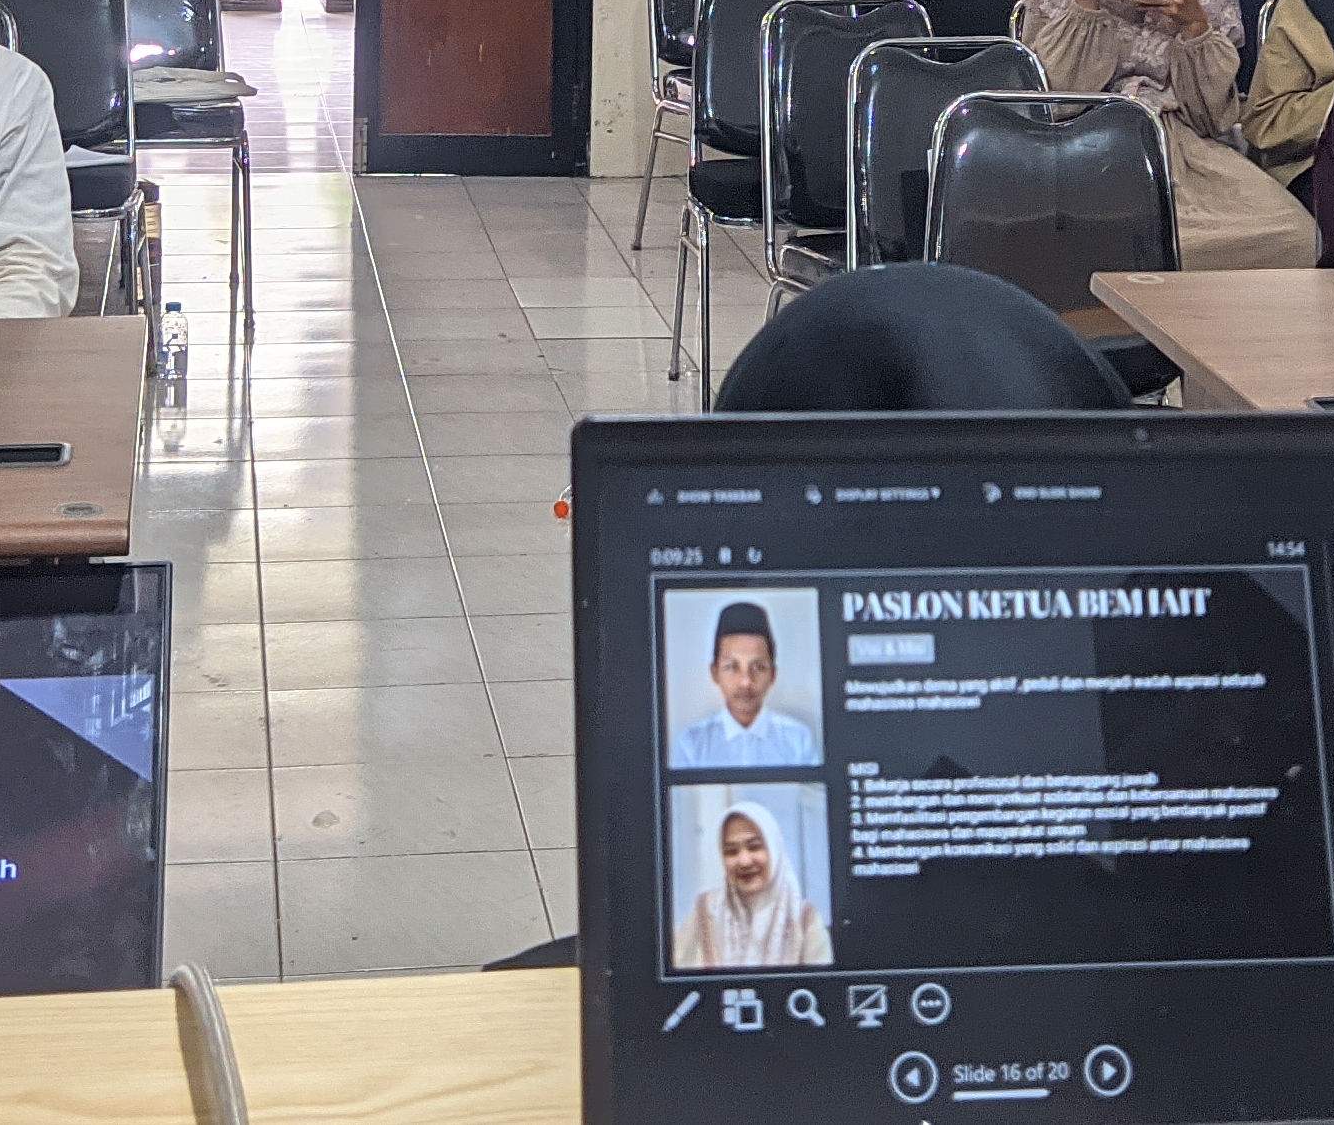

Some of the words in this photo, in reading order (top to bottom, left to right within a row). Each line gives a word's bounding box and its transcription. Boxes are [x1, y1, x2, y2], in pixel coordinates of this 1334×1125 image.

[843, 591, 962, 621] PASLON
[968, 590, 1072, 619] KETUA
[1078, 589, 1143, 617] BEM
[1148, 588, 1211, 616] IAIT
[953, 1065, 996, 1083] Slide
[1001, 1063, 1022, 1081] 16
[1025, 1062, 1044, 1081] of
[1048, 1062, 1070, 1081] 20
